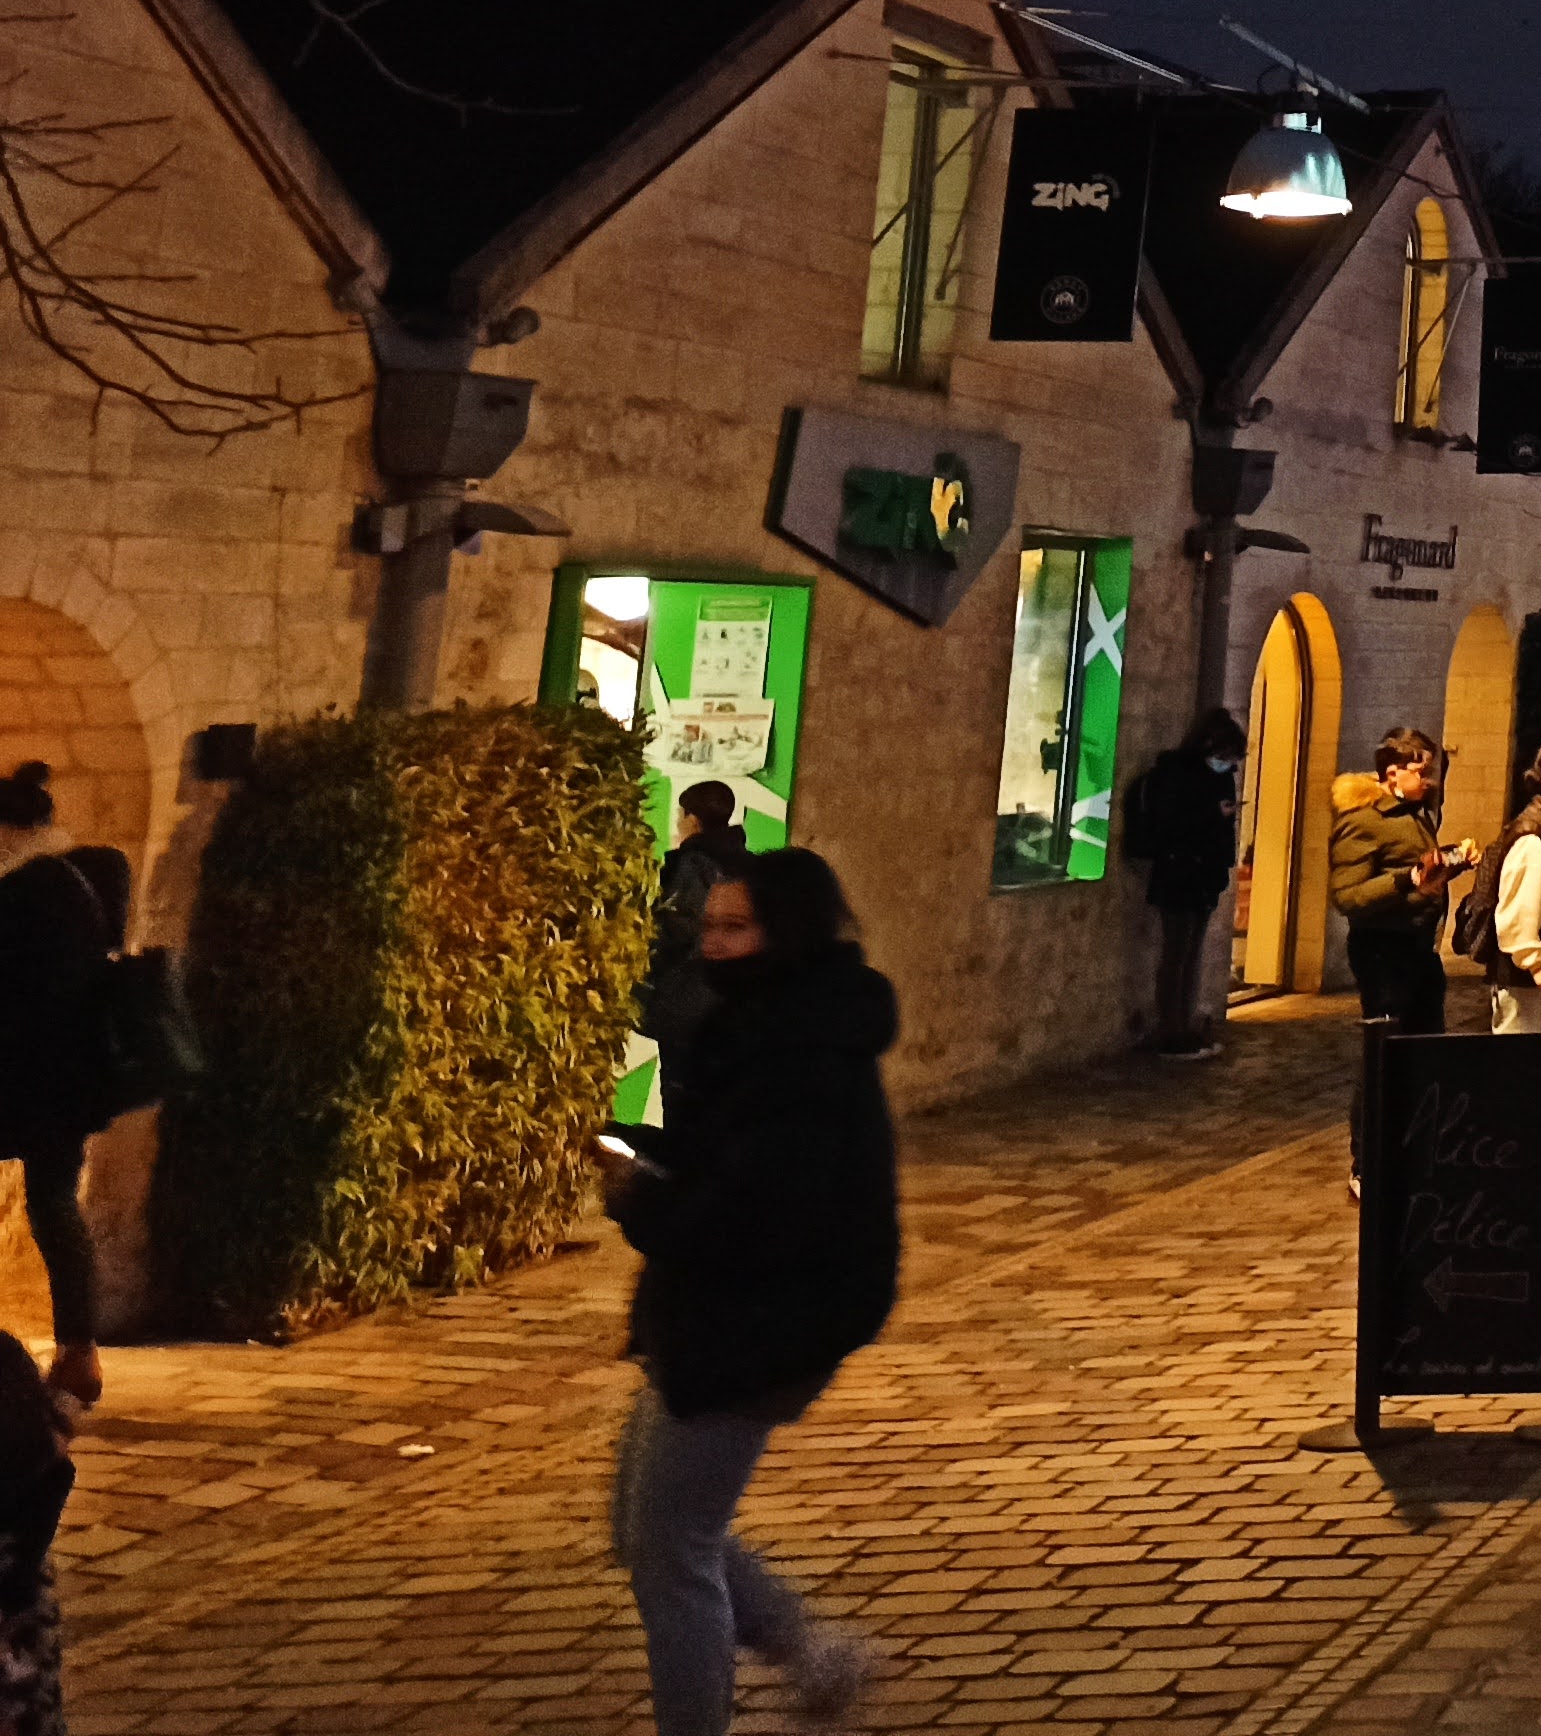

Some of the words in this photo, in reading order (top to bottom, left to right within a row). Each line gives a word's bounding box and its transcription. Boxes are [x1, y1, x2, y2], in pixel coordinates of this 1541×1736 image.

[1031, 181, 1110, 212] ZING
[1360, 513, 1458, 581] Fragonard
[1401, 1080, 1521, 1173] Alice
